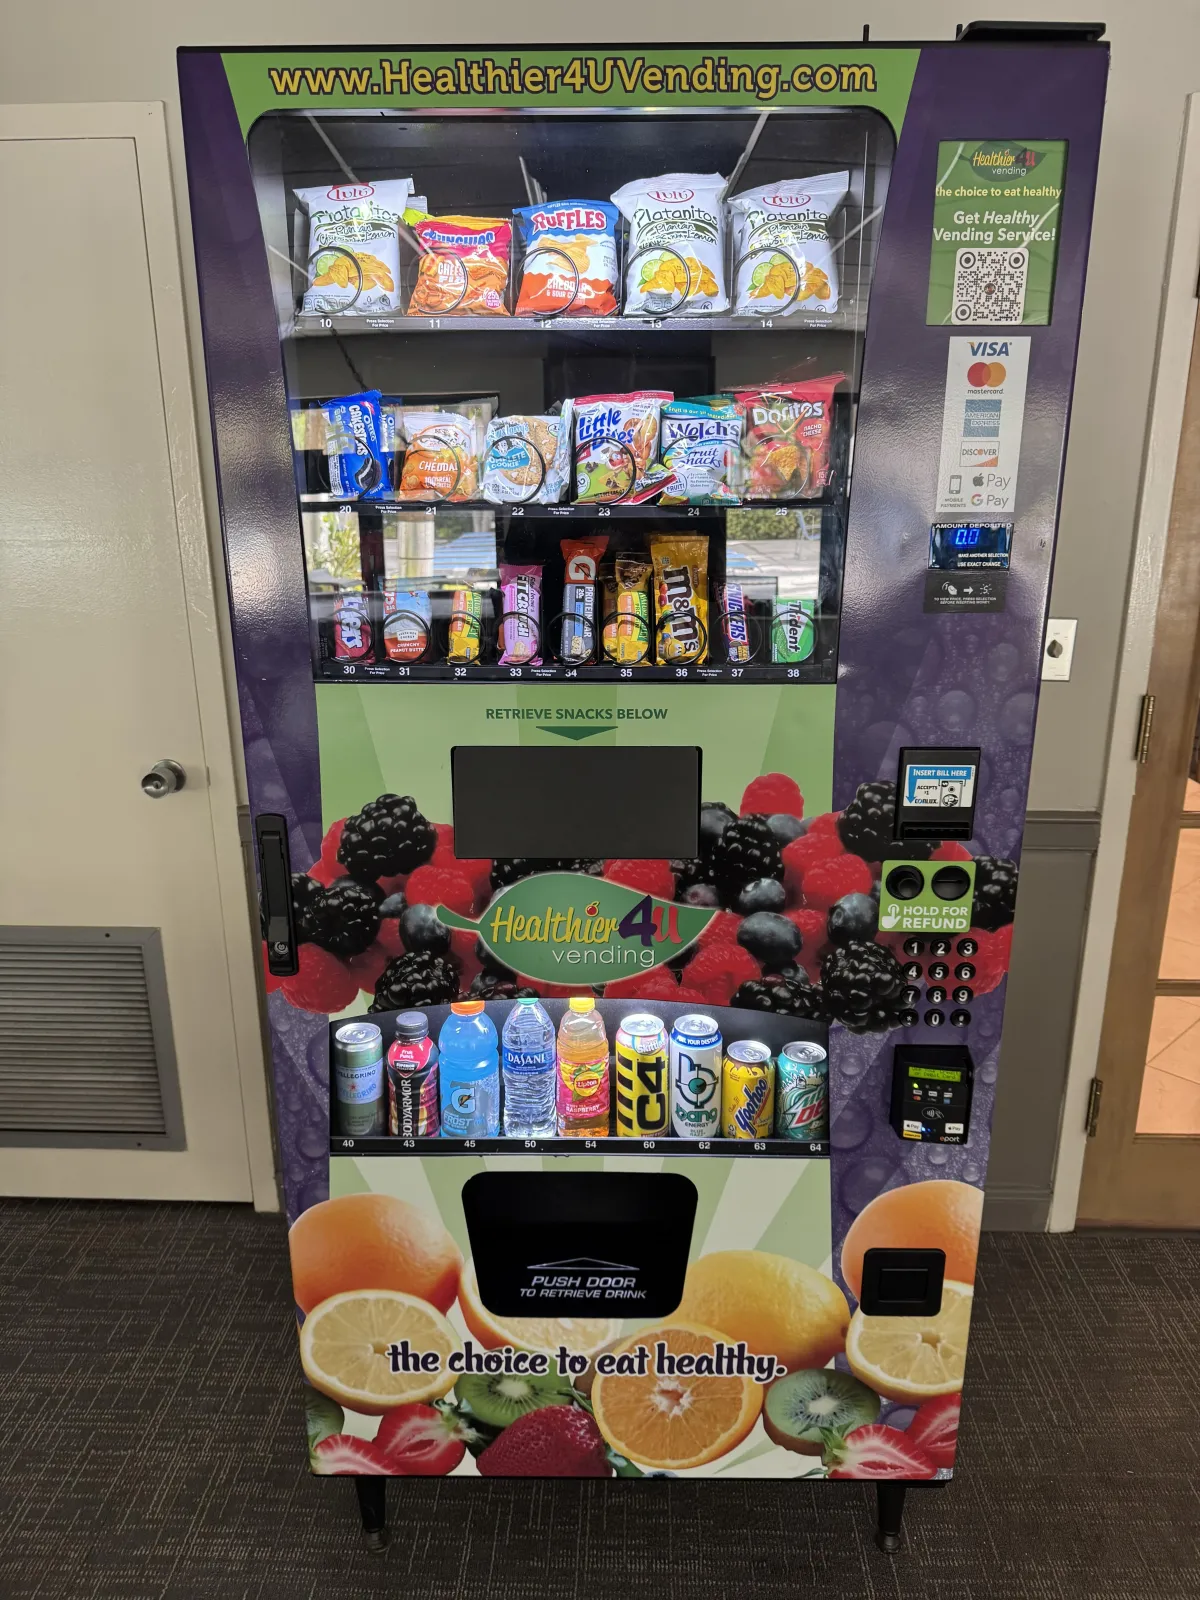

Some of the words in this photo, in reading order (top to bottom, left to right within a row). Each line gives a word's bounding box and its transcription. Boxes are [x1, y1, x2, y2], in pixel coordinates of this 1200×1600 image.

[268, 57, 877, 101] www.Healthier4UVending.com
[992, 167, 1027, 176] vending
[935, 187, 953, 197] the
[954, 187, 988, 197] choice
[990, 188, 1002, 197] to
[1004, 188, 1020, 197] eat
[1022, 188, 1062, 199] healthy
[531, 210, 607, 234] RUFFLES
[635, 206, 719, 229] Platanitos
[953, 211, 981, 225] Get
[983, 211, 1040, 228] Healthy
[933, 228, 994, 245] Vending
[997, 228, 1056, 242] Service!
[320, 318, 332, 329] 10
[429, 318, 441, 329] 11
[540, 319, 552, 329] 12
[760, 320, 773, 328] 14
[968, 342, 1010, 358] VISA
[752, 401, 825, 426] Doritos
[579, 407, 623, 441] Little
[803, 424, 822, 432] NACHO
[667, 421, 740, 443] Welch's
[986, 474, 1011, 490] Pay
[986, 494, 1010, 508] Pay
[340, 506, 352, 515] 20
[425, 507, 437, 515] 21
[512, 508, 524, 516] 22
[598, 508, 611, 516] 23
[688, 508, 700, 516] 24
[775, 508, 788, 516] 25
[969, 522, 1013, 530] DEPOSITED
[517, 574, 530, 592] FIT
[584, 586, 595, 619] PROTEIN
[788, 600, 802, 654] Trident
[344, 666, 356, 675] 30
[399, 667, 410, 676] 31
[454, 668, 467, 677] 32
[510, 668, 522, 677] 33
[565, 668, 577, 677] 34
[620, 668, 632, 677] 35
[676, 668, 688, 677] 36
[731, 668, 743, 677] 37
[787, 668, 800, 677] 38
[485, 708, 553, 720] RETRIEVE
[555, 708, 613, 720] SNACKS
[616, 708, 669, 720] BELOW
[913, 769, 936, 777] INSERT
[936, 769, 950, 777] BILL
[903, 906, 939, 916] HOLD
[942, 906, 968, 917] FOR
[902, 917, 967, 929] REFUND
[911, 942, 918, 954] 1
[936, 943, 946, 954] 2
[963, 942, 973, 955] 3
[552, 945, 656, 969] vending
[908, 965, 918, 978] 4
[934, 966, 944, 978] 5
[961, 967, 971, 979] 6
[907, 990, 915, 1002] 7
[933, 991, 942, 1003] 8
[958, 990, 968, 1002] 9
[931, 1013, 940, 1025] 0
[687, 1038, 701, 1047] YOUR
[507, 1052, 545, 1067] DASANI
[577, 1078, 599, 1089] Lipton
[636, 1057, 667, 1130] C4
[401, 1079, 413, 1138] BODYARMOR
[684, 1121, 710, 1129] ENERGY
[342, 1139, 355, 1148] 40
[403, 1139, 415, 1148] 43
[463, 1140, 476, 1149] 45
[524, 1140, 536, 1149] 50
[585, 1140, 597, 1149] 54
[643, 1141, 655, 1150] 60
[698, 1142, 711, 1150] 62
[754, 1143, 766, 1151] 63
[809, 1144, 822, 1152] 64
[531, 1276, 581, 1287] PUSH
[586, 1276, 636, 1288] DOOR
[520, 1288, 536, 1297] TO
[539, 1288, 602, 1299] RETRIEVE
[605, 1289, 647, 1300] DRINK
[387, 1341, 440, 1374] the
[448, 1341, 548, 1375] choice
[555, 1346, 589, 1375] to
[597, 1346, 650, 1375] eat
[655, 1341, 788, 1382] healthy.
